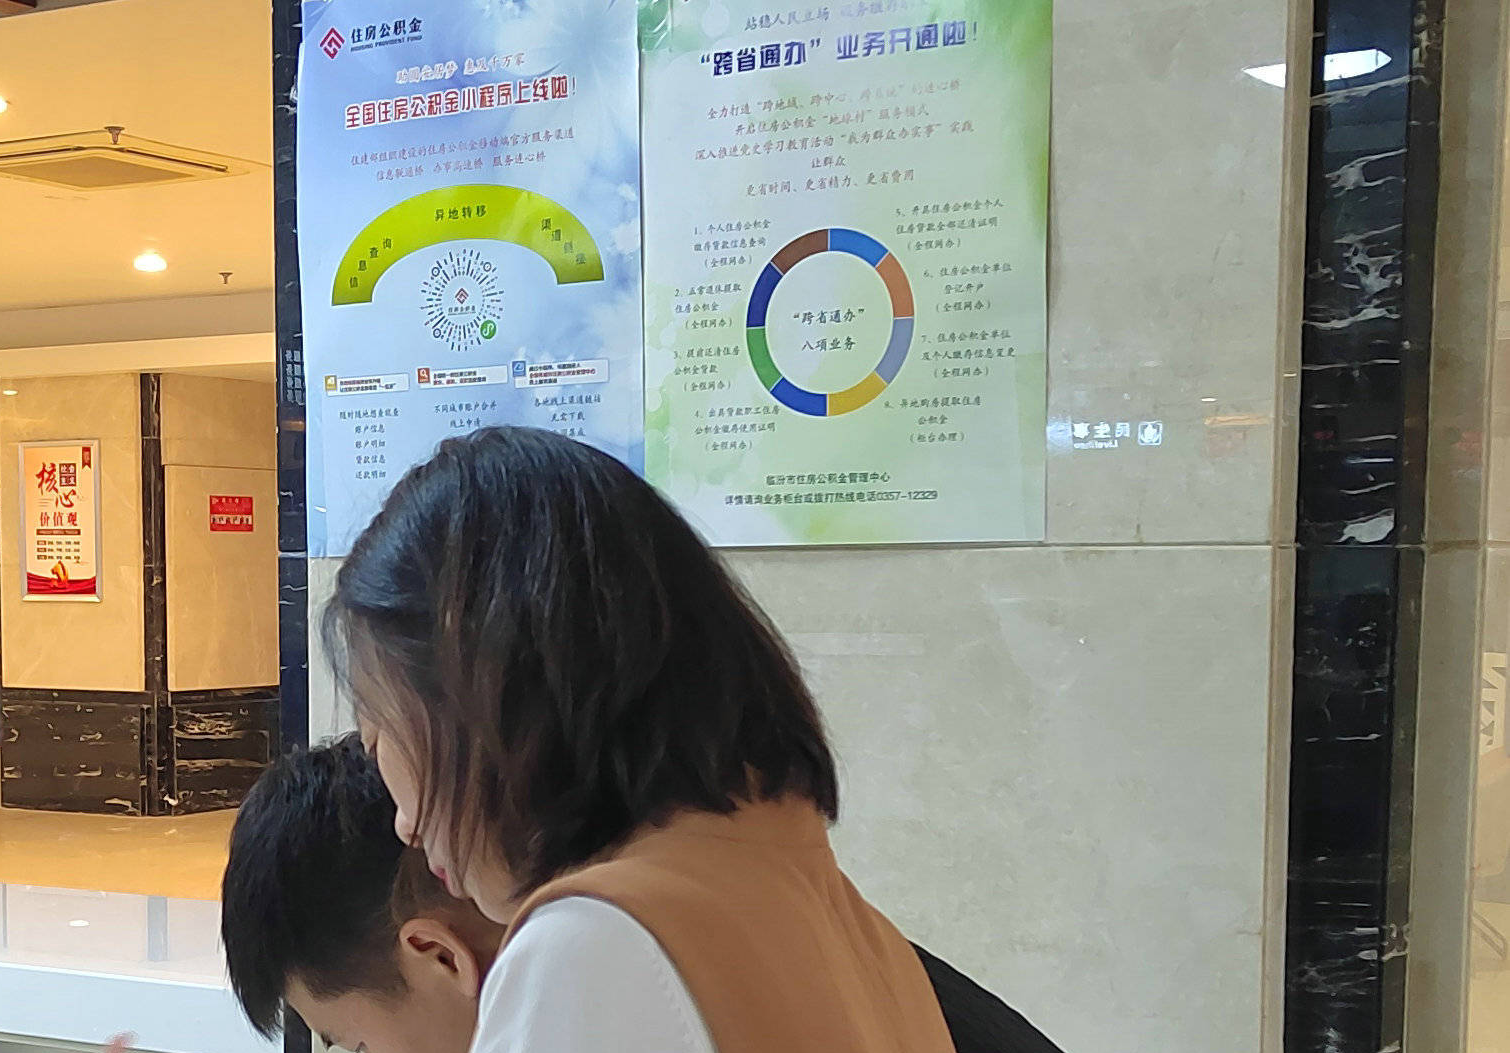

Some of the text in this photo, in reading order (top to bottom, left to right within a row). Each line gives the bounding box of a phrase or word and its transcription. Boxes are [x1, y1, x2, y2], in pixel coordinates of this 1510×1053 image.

[351, 17, 423, 44] 住房公积金
[811, 156, 846, 169] 让群众
[435, 205, 487, 221] 异地转移
[801, 336, 856, 352] 八项业务
[40, 511, 78, 527] 价值观
